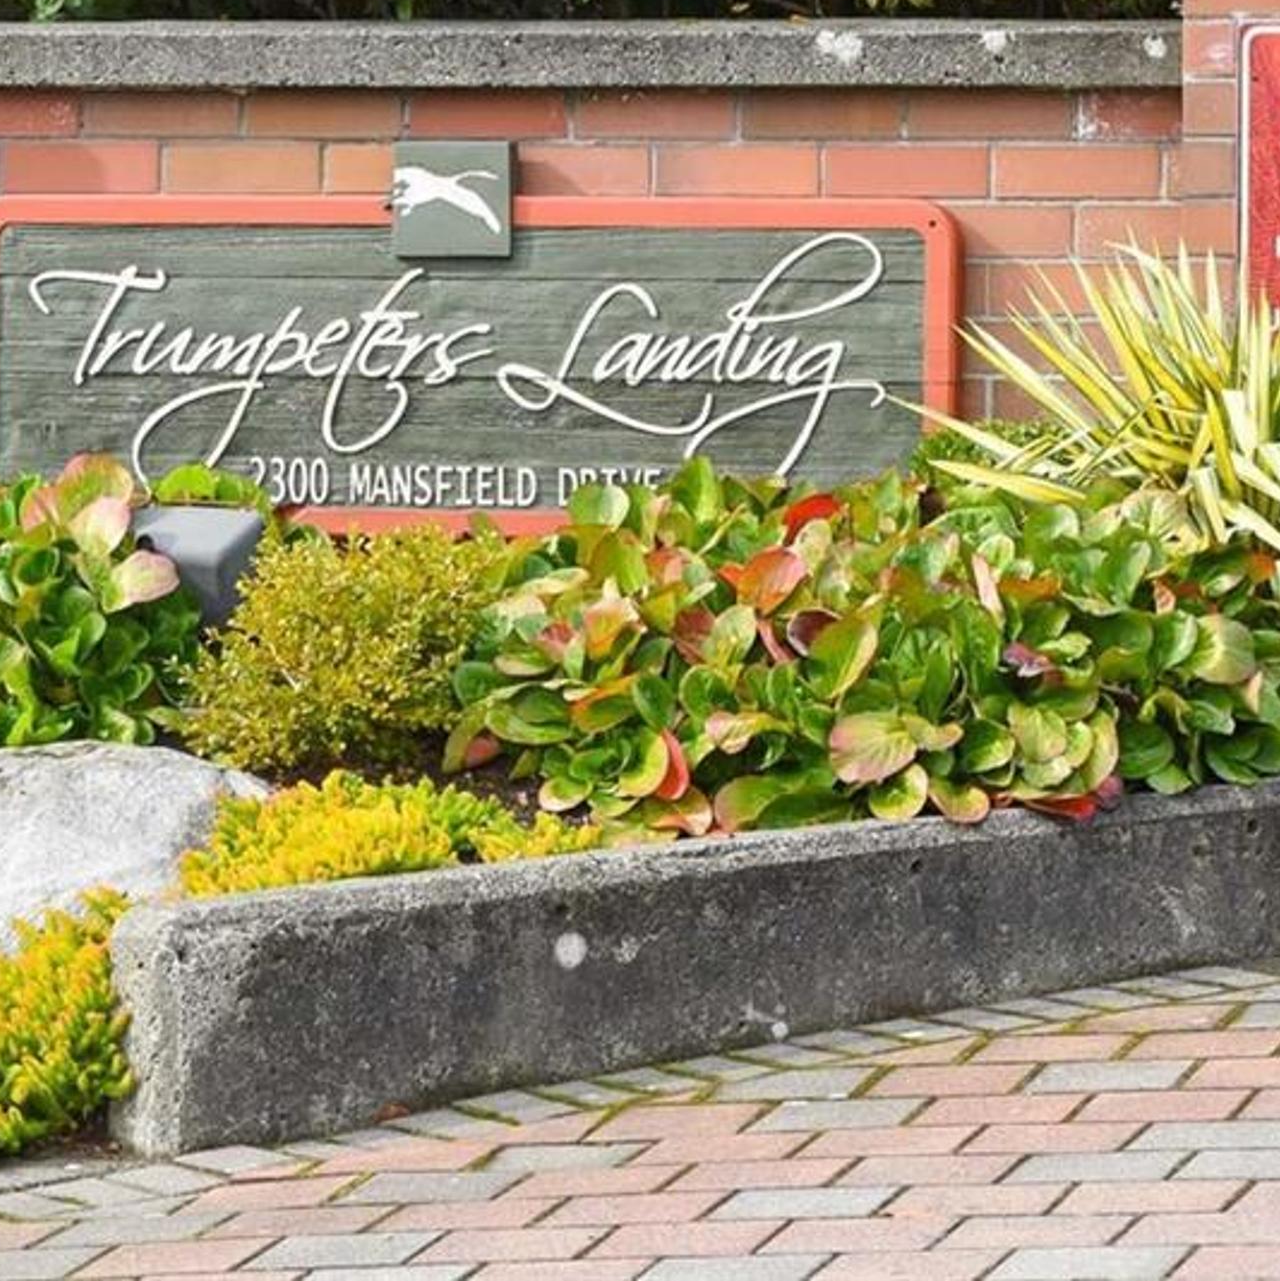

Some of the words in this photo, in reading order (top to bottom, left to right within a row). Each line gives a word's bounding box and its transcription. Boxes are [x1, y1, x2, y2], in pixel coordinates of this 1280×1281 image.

[28, 264, 494, 501] Trumpeters
[497, 232, 887, 479] Landing
[249, 456, 330, 505] 2300
[348, 463, 537, 508] MANSFIELD
